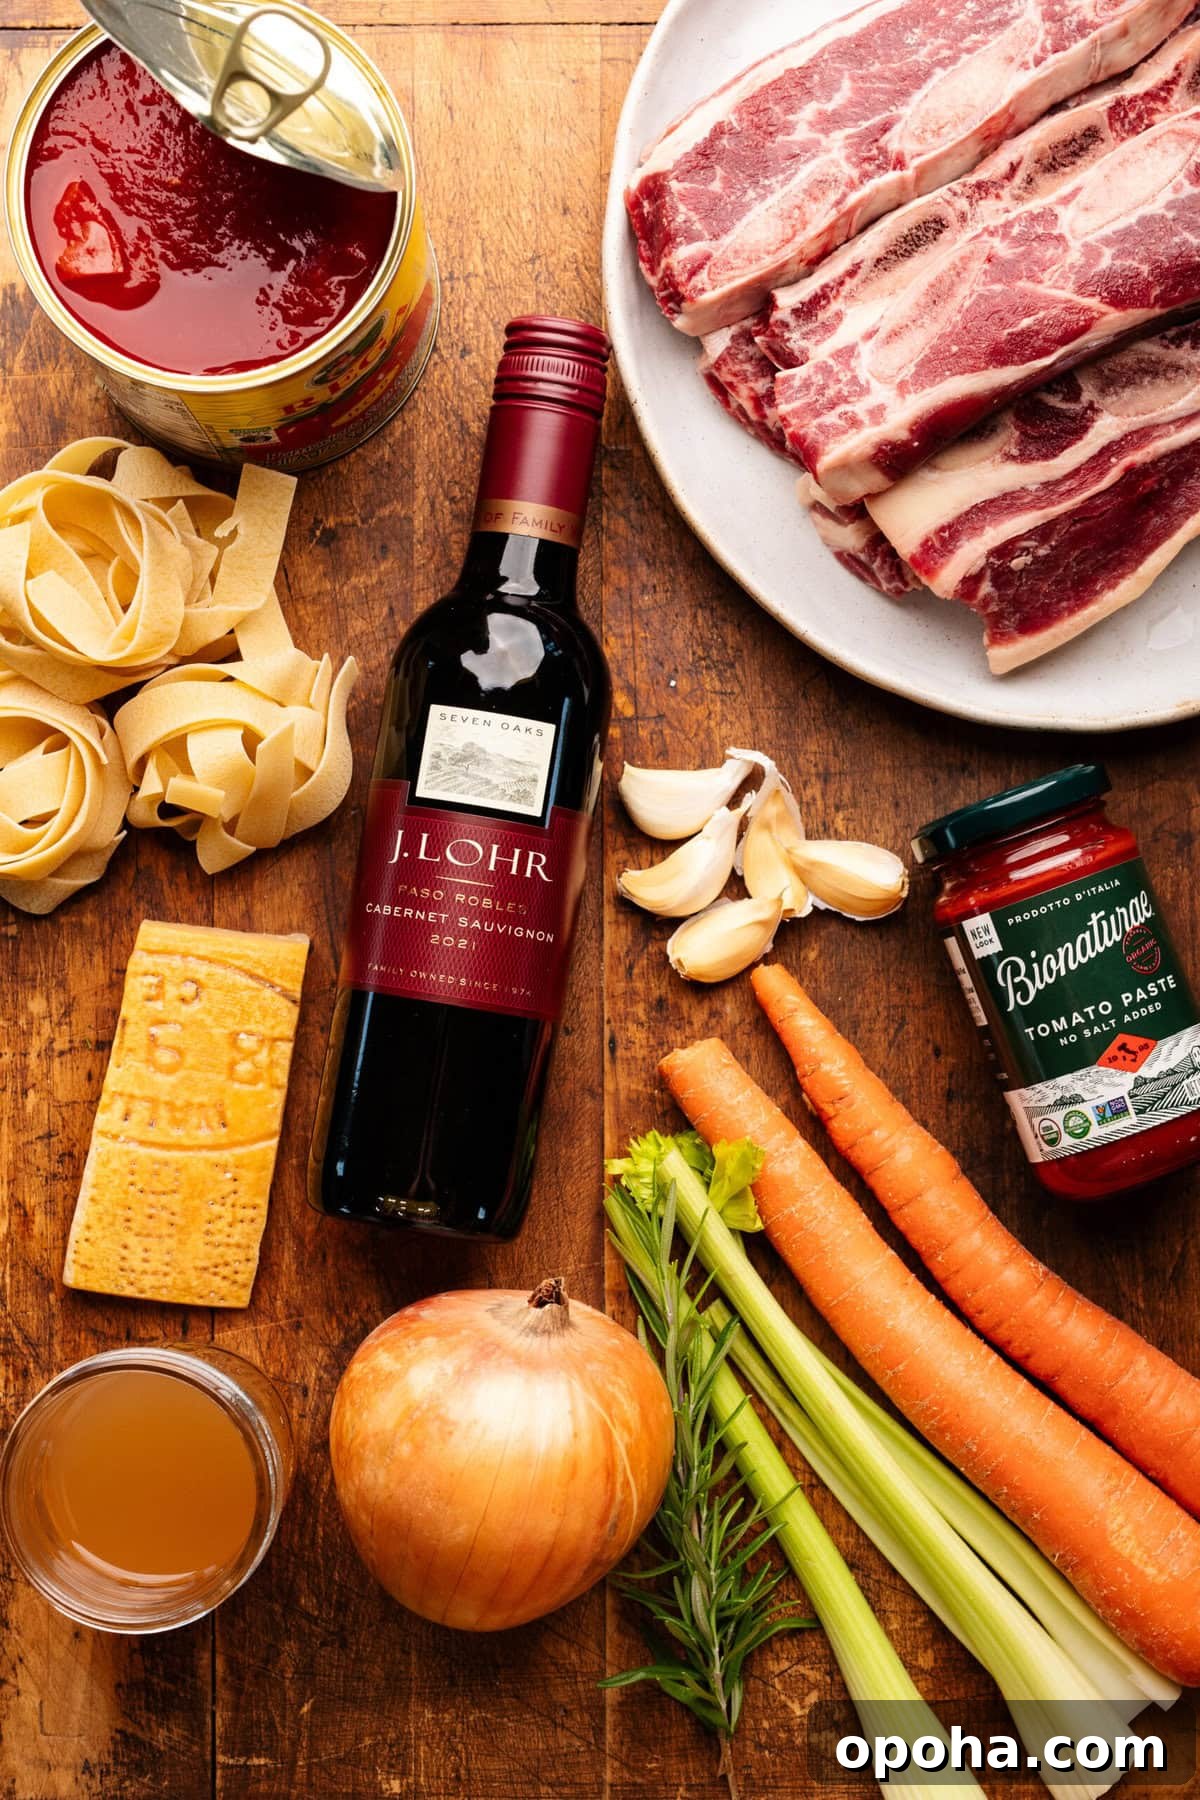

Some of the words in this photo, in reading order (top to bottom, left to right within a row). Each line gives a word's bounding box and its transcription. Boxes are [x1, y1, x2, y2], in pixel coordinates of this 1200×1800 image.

[511, 511, 568, 534] FAMILY
[439, 712, 492, 728] SEVEN
[500, 721, 544, 737] OAKS
[397, 884, 444, 901] PASO
[454, 892, 528, 916] ROBLES
[1007, 897, 1071, 926] PRODOTTO
[1074, 878, 1121, 902] D'ITALIA
[365, 902, 449, 925] CABERNET
[457, 916, 555, 944] SAUVIGNON
[970, 923, 991, 942] NEW
[430, 934, 477, 951] 2021
[975, 937, 995, 950] LOOK
[996, 890, 1153, 1012] Bionaturae
[367, 962, 405, 977] FAMILY
[410, 970, 455, 984] OWNED
[459, 977, 499, 993] SINCE
[1024, 1000, 1113, 1041] TOMATO
[1121, 974, 1177, 1007] PASTE
[1059, 1034, 1078, 1047] NO
[1083, 1018, 1117, 1038] SALT
[1123, 1001, 1163, 1024] ADDED
